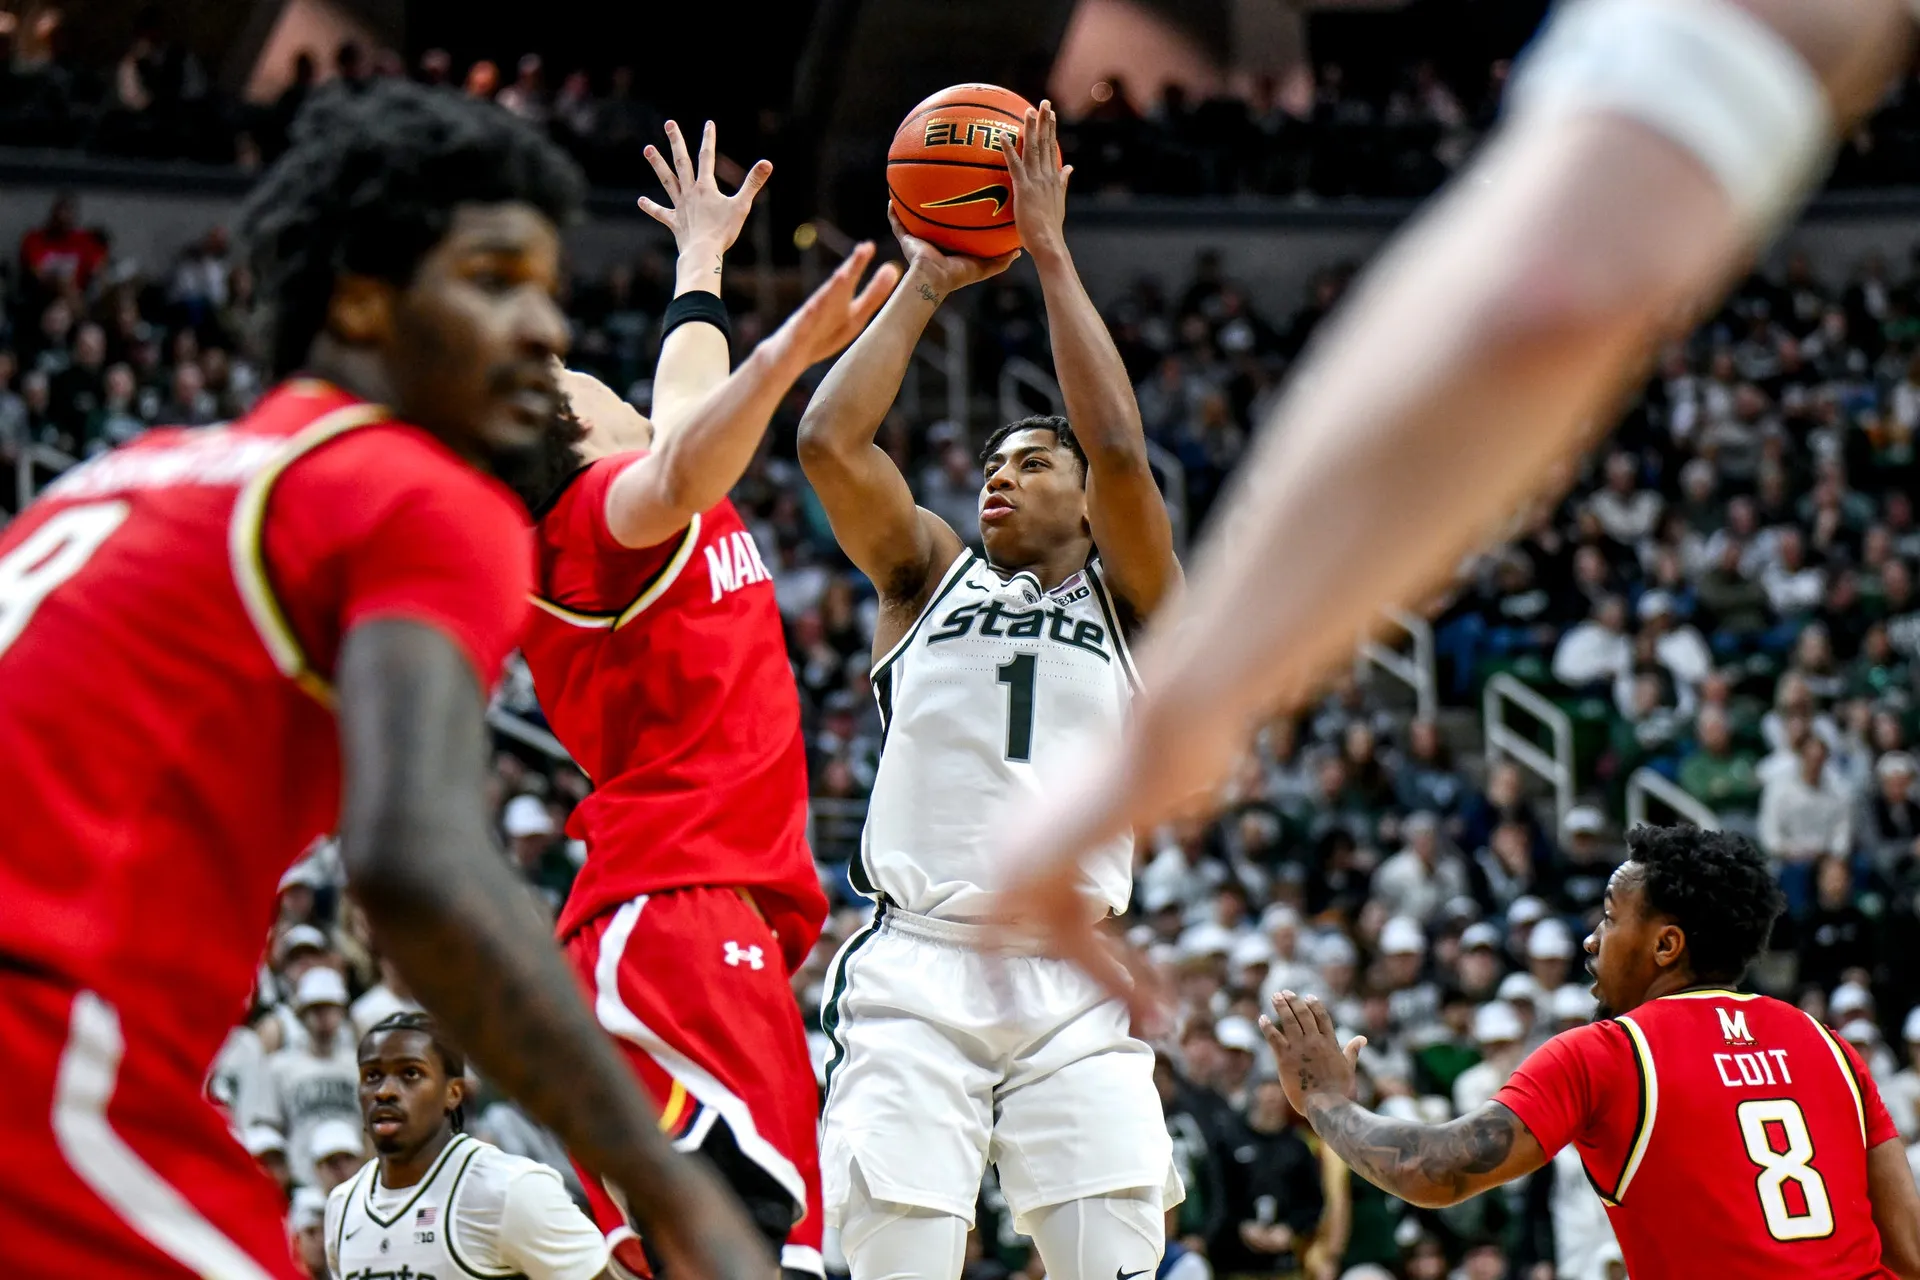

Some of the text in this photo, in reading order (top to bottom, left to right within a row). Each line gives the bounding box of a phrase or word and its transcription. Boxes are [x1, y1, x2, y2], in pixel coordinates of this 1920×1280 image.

[924, 123, 1018, 153] ELITE
[995, 651, 1040, 764] 1
[1714, 1007, 1755, 1041] M
[1713, 1050, 1792, 1087] COIT
[1737, 1099, 1836, 1241] 8
